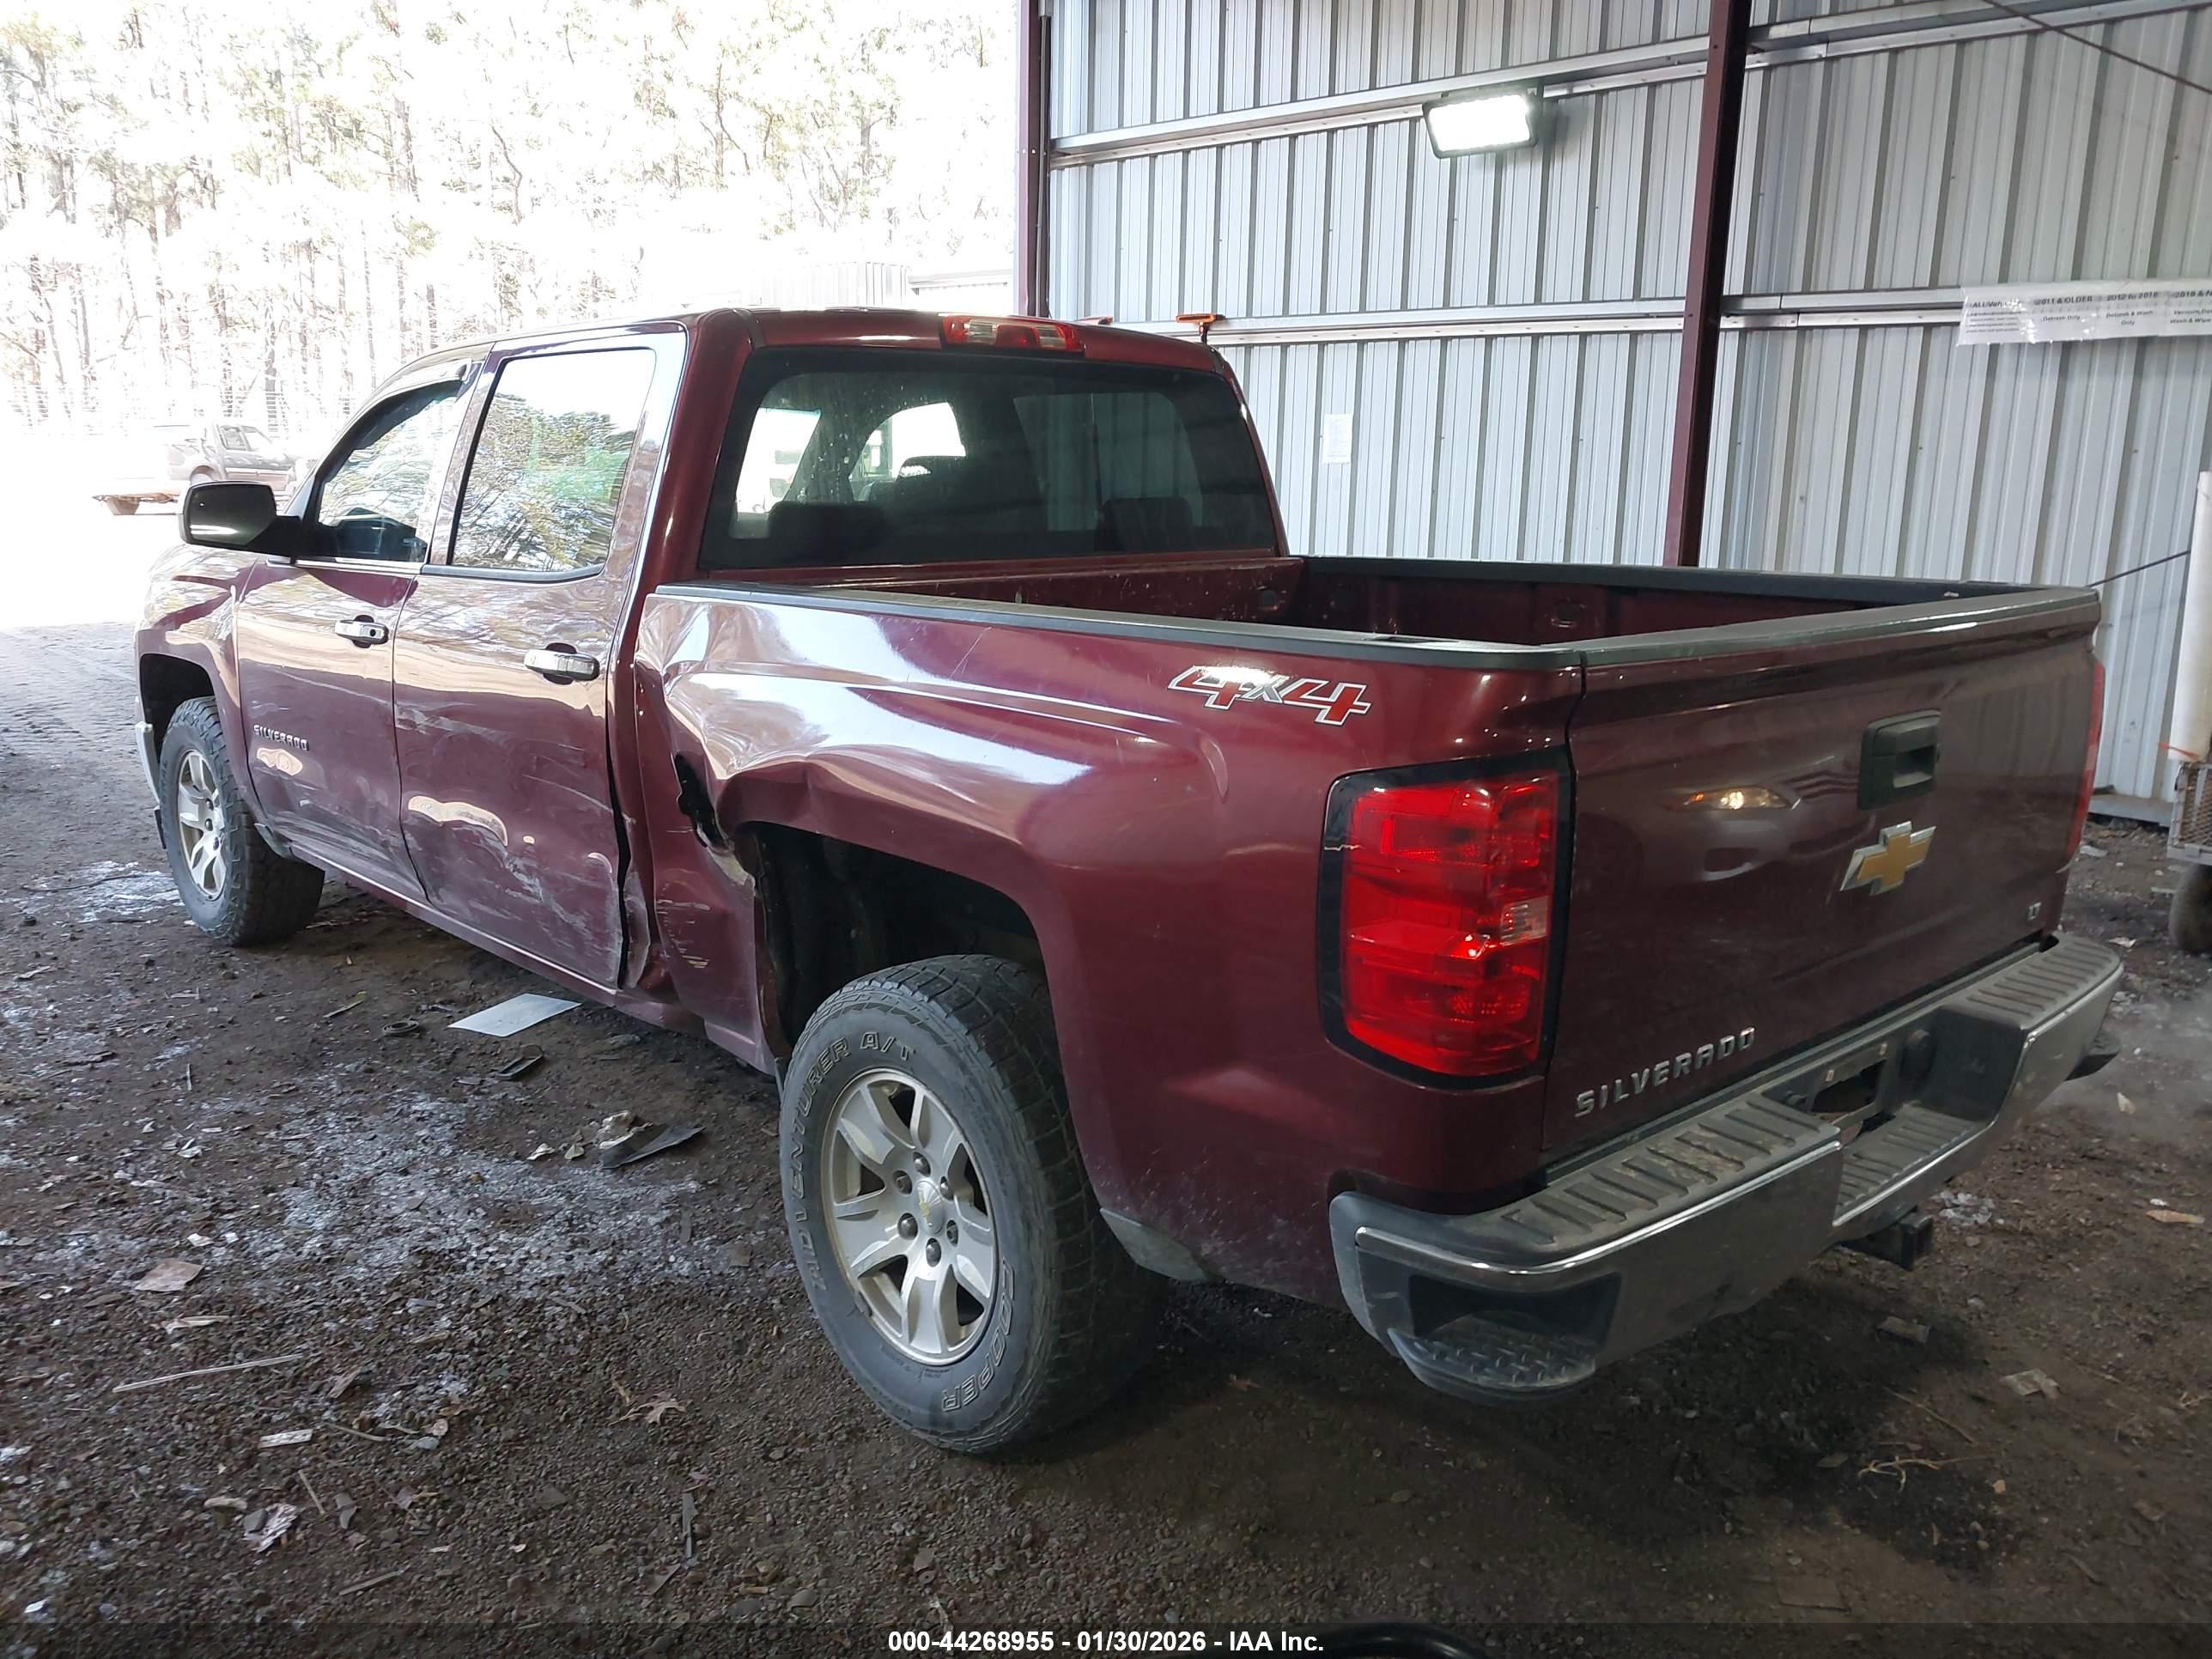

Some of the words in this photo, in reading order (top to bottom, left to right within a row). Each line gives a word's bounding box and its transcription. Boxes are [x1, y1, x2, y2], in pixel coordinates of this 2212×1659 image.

[2063, 295, 2093, 304] OLDER
[253, 724, 309, 751] SILVERADO
[860, 1030, 915, 1062] A/T
[1575, 1026, 1756, 1118] SILVERADO
[941, 1257, 1015, 1413] COOPER
